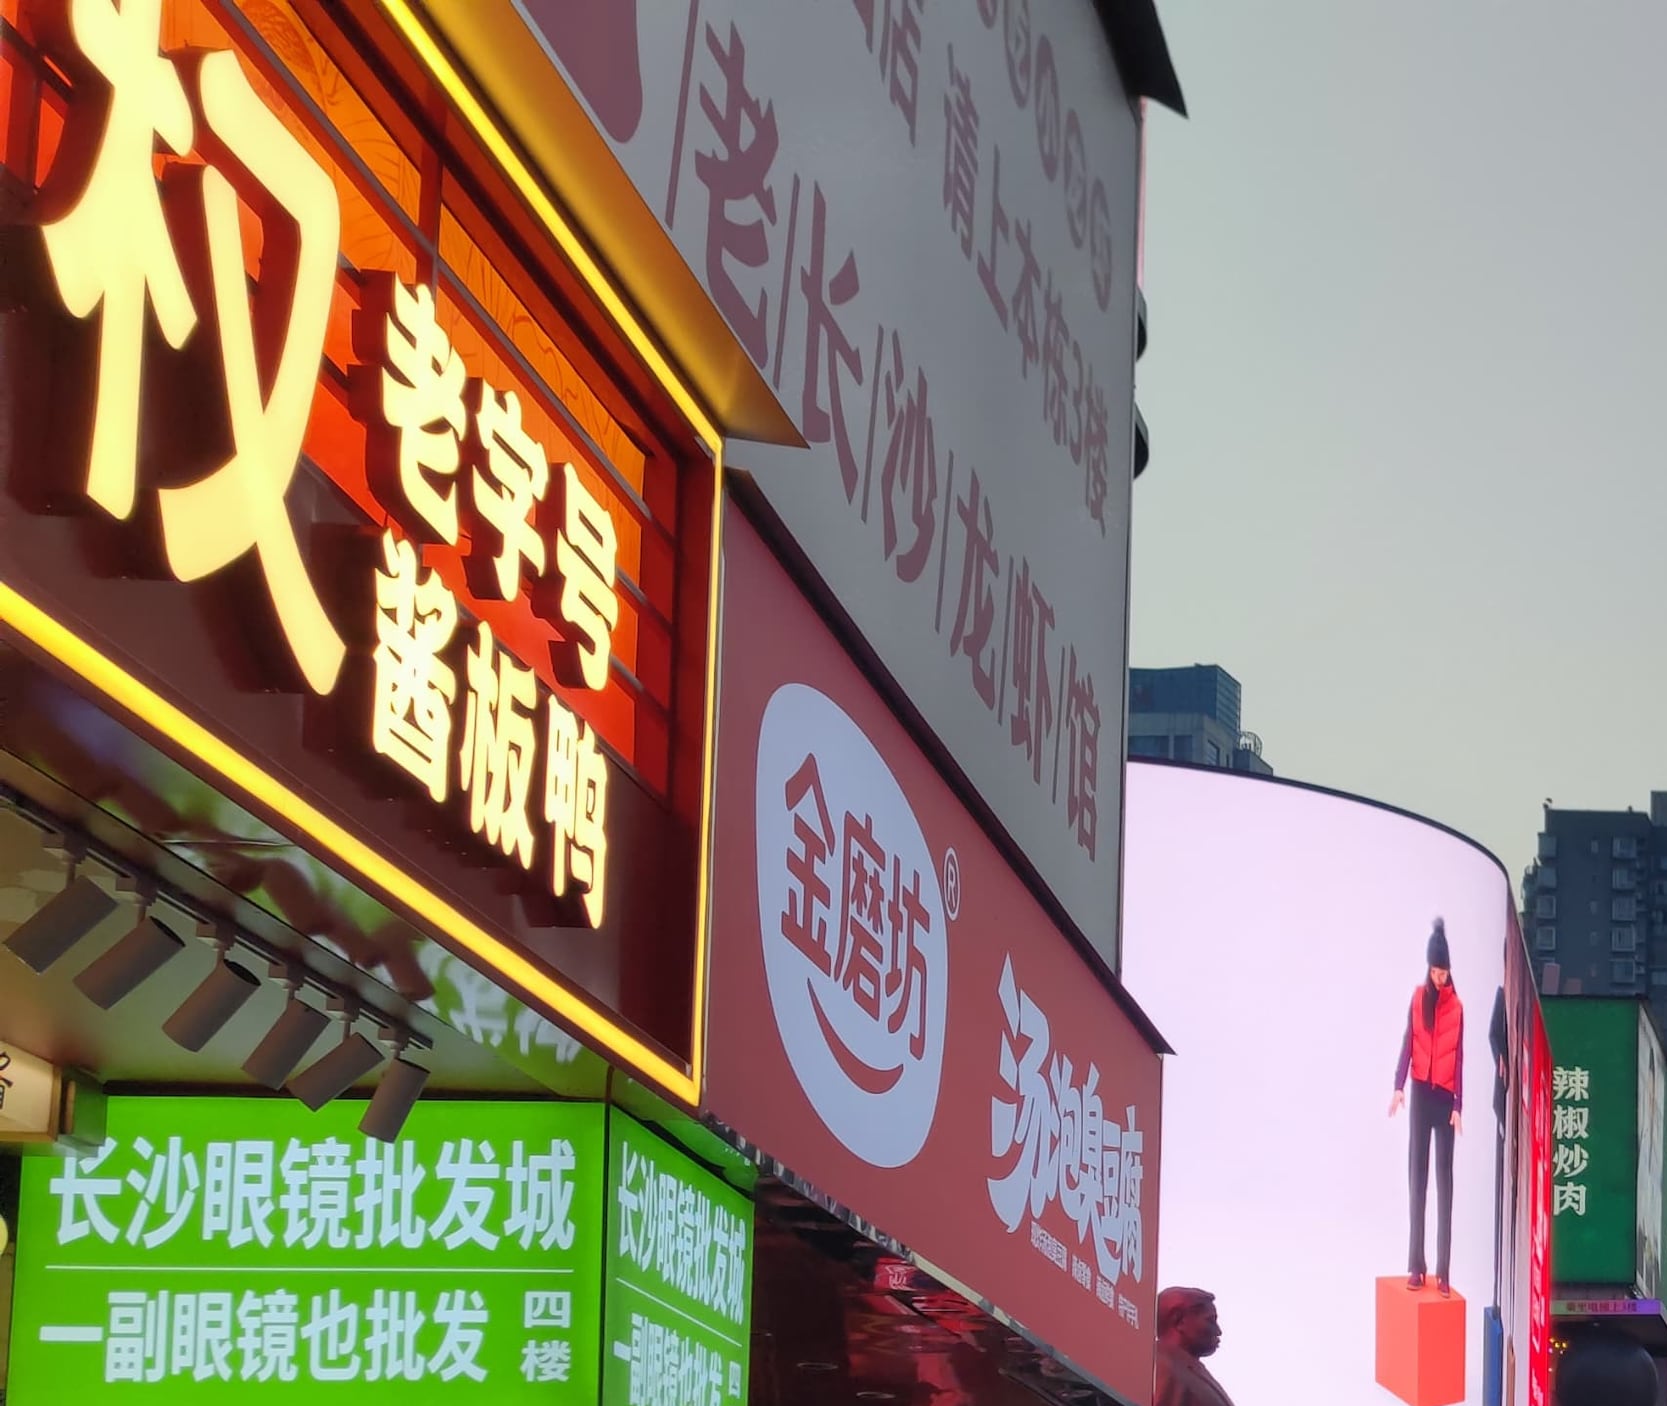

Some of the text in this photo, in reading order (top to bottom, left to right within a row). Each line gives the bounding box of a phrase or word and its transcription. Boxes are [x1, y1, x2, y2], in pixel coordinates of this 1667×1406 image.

[383, 272, 618, 692] 老字号
[372, 527, 608, 932] 酱板鸭
[781, 752, 930, 1060] 金磨坊
[50, 1136, 575, 1252] 长沙眼镜批发城
[986, 953, 1145, 1284] 汤泡臭豆腐
[1552, 1065, 1590, 1217] 辣椒炒肉
[617, 1141, 746, 1326] 长沙眼镜批发城
[38, 1288, 488, 1383] 一副眼镜也批发
[520, 1290, 572, 1382] 四楼
